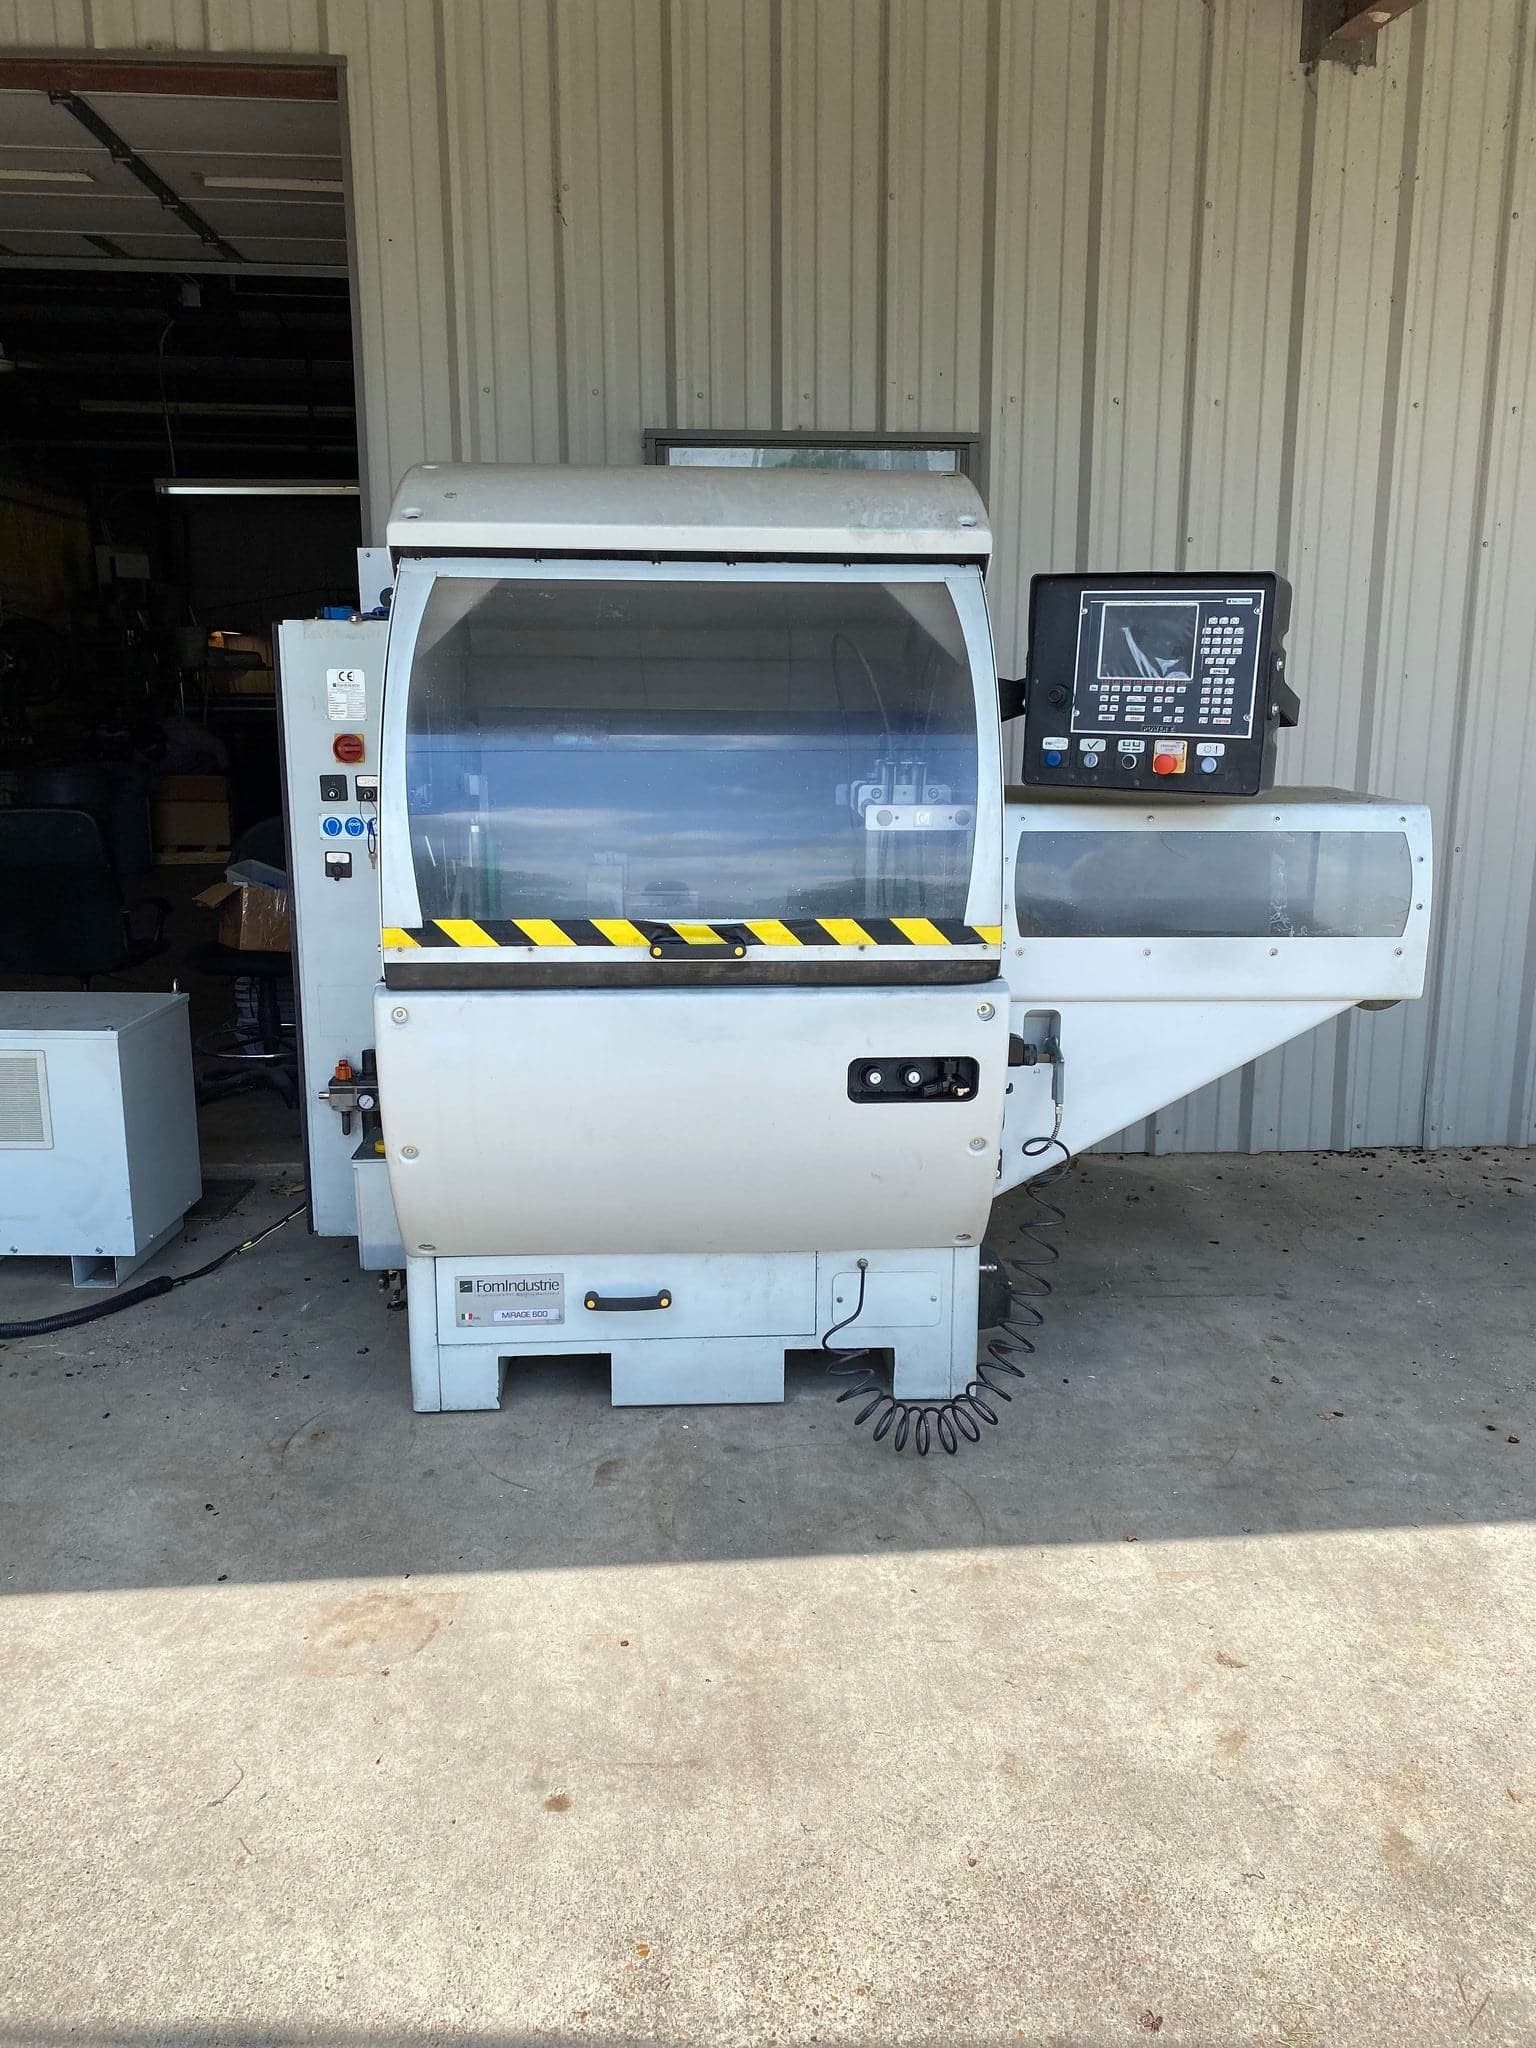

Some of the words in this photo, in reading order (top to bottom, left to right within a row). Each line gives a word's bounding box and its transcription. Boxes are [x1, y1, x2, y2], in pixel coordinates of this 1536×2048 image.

[338, 671, 354, 682] CE
[476, 1278, 560, 1293] FomIndustrie
[501, 1311, 531, 1319] MIRAGE
